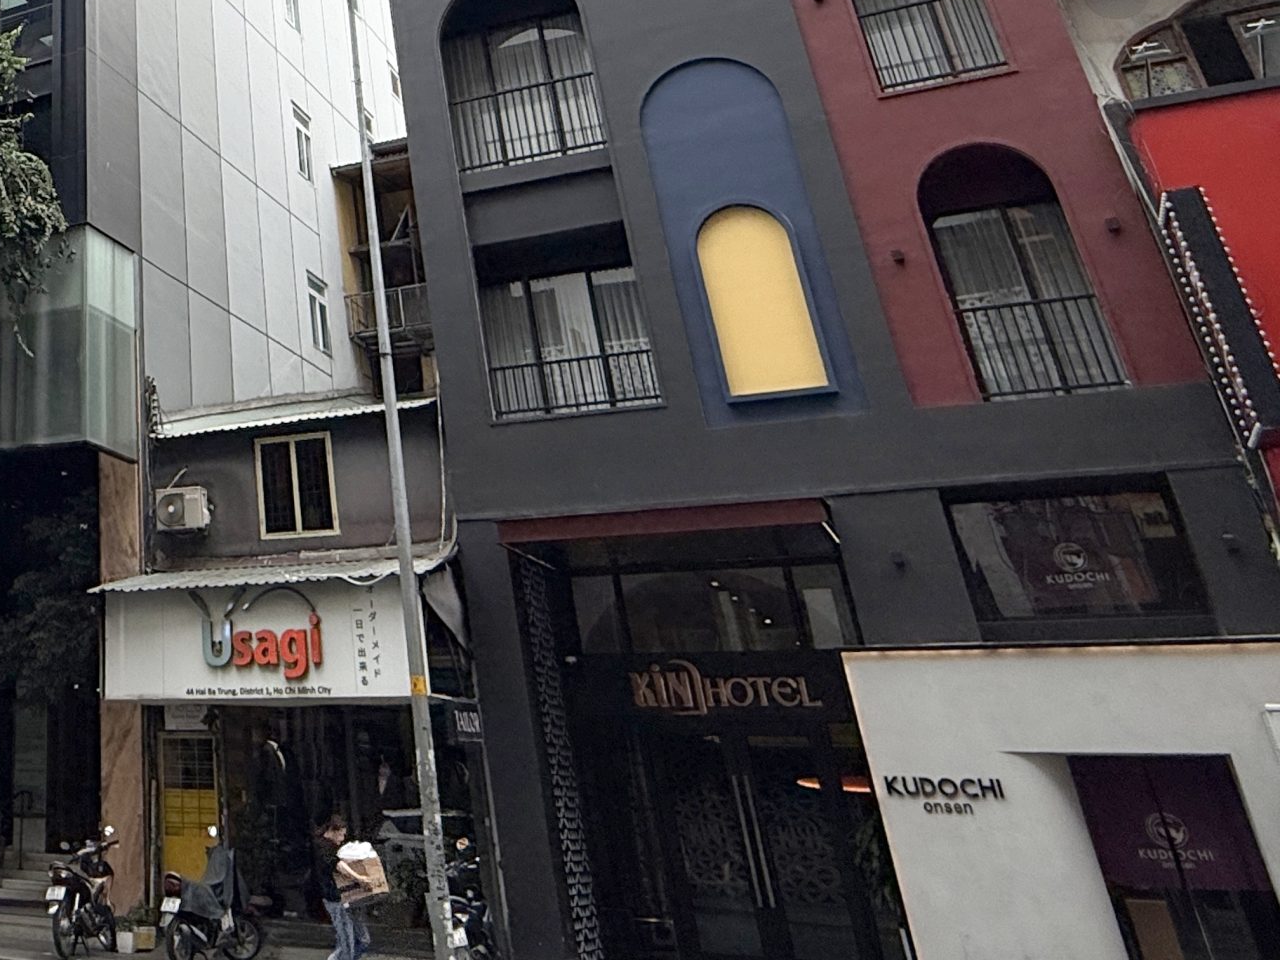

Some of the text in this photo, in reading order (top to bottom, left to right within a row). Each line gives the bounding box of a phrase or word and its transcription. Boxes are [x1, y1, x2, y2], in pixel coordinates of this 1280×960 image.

[1046, 571, 1111, 584] KUDOCHI
[201, 611, 322, 679] Usagi
[352, 608, 368, 686] 一日で出来る
[196, 687, 206, 696] Hai
[239, 686, 264, 696] District
[273, 686, 283, 695] Ho
[285, 686, 296, 695] Chi
[297, 685, 316, 695] Minh
[317, 685, 332, 696] City
[704, 676, 823, 707] HOTEL
[883, 775, 1005, 800] KUDOCHI
[923, 801, 974, 815] onsen
